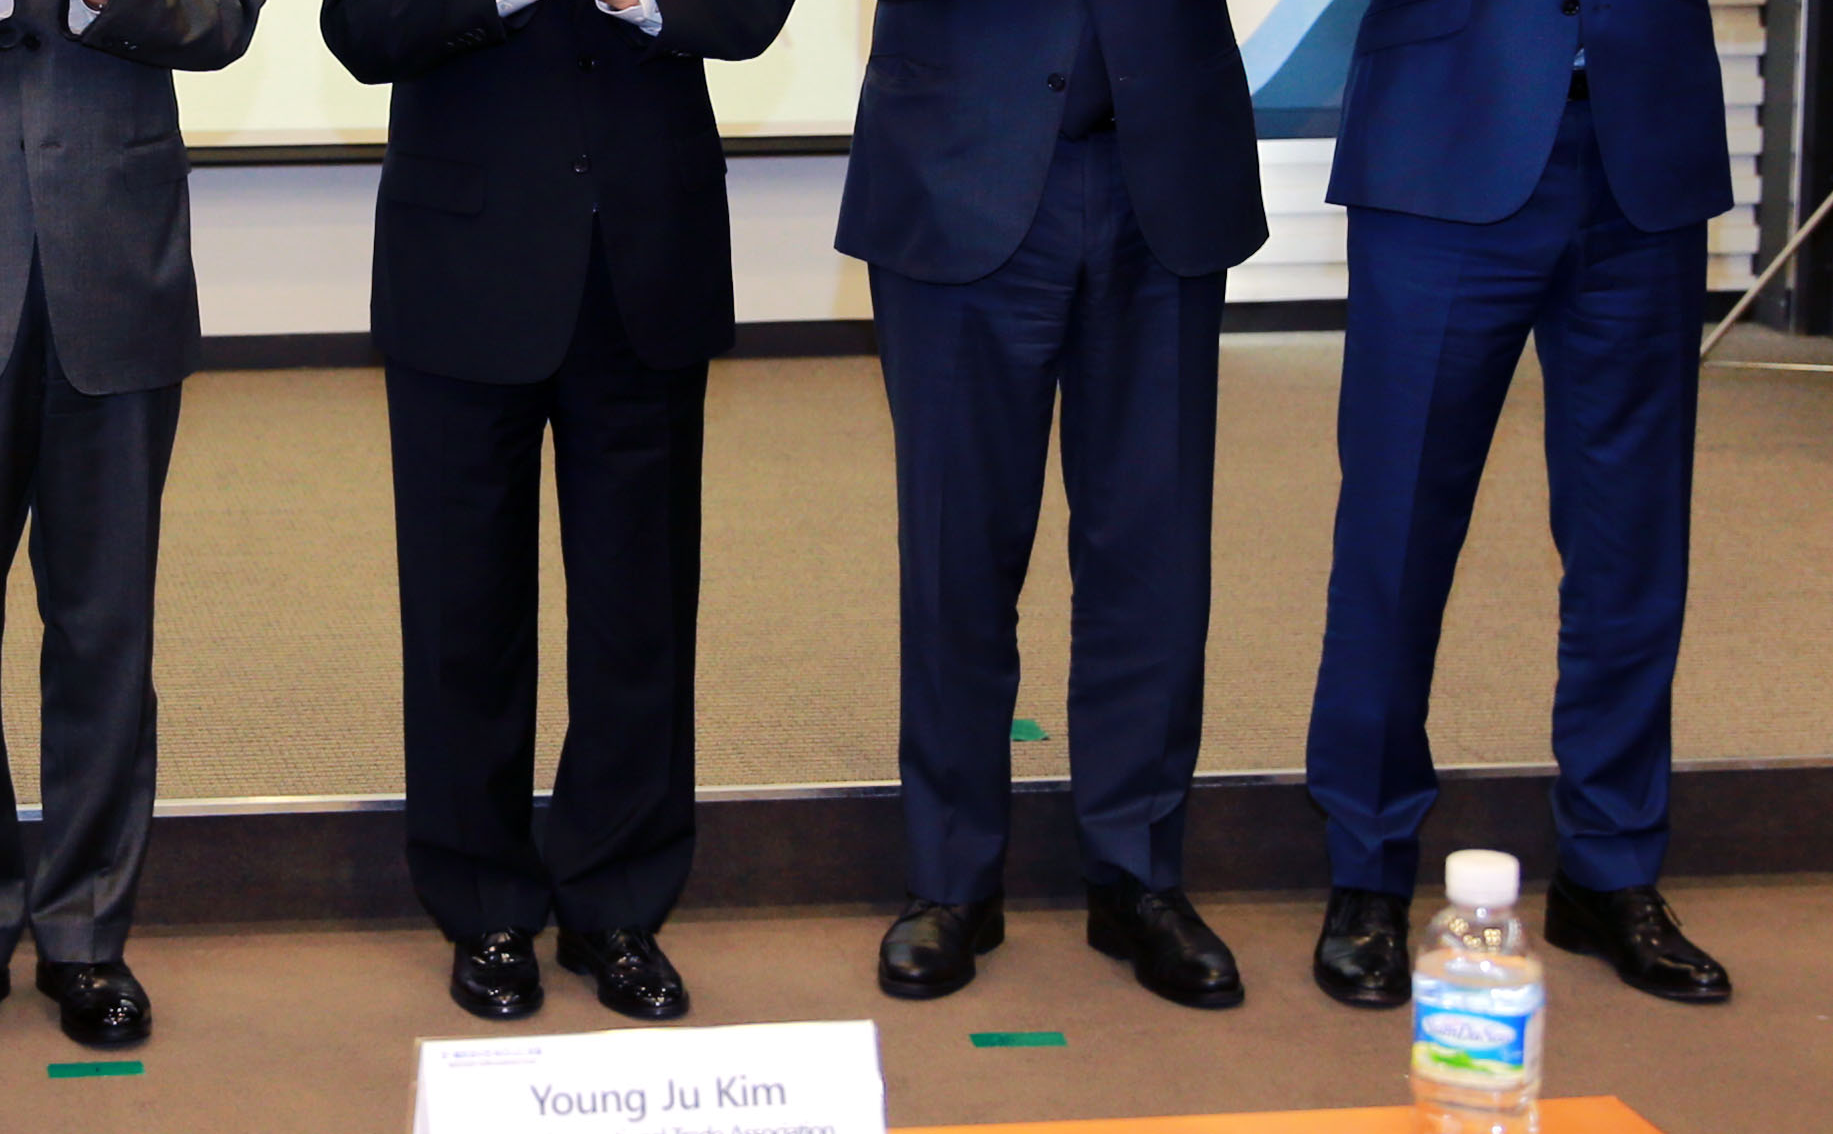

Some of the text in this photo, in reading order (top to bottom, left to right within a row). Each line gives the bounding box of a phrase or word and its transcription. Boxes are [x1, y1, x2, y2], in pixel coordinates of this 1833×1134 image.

[530, 1074, 787, 1123] Young Ju Kim
